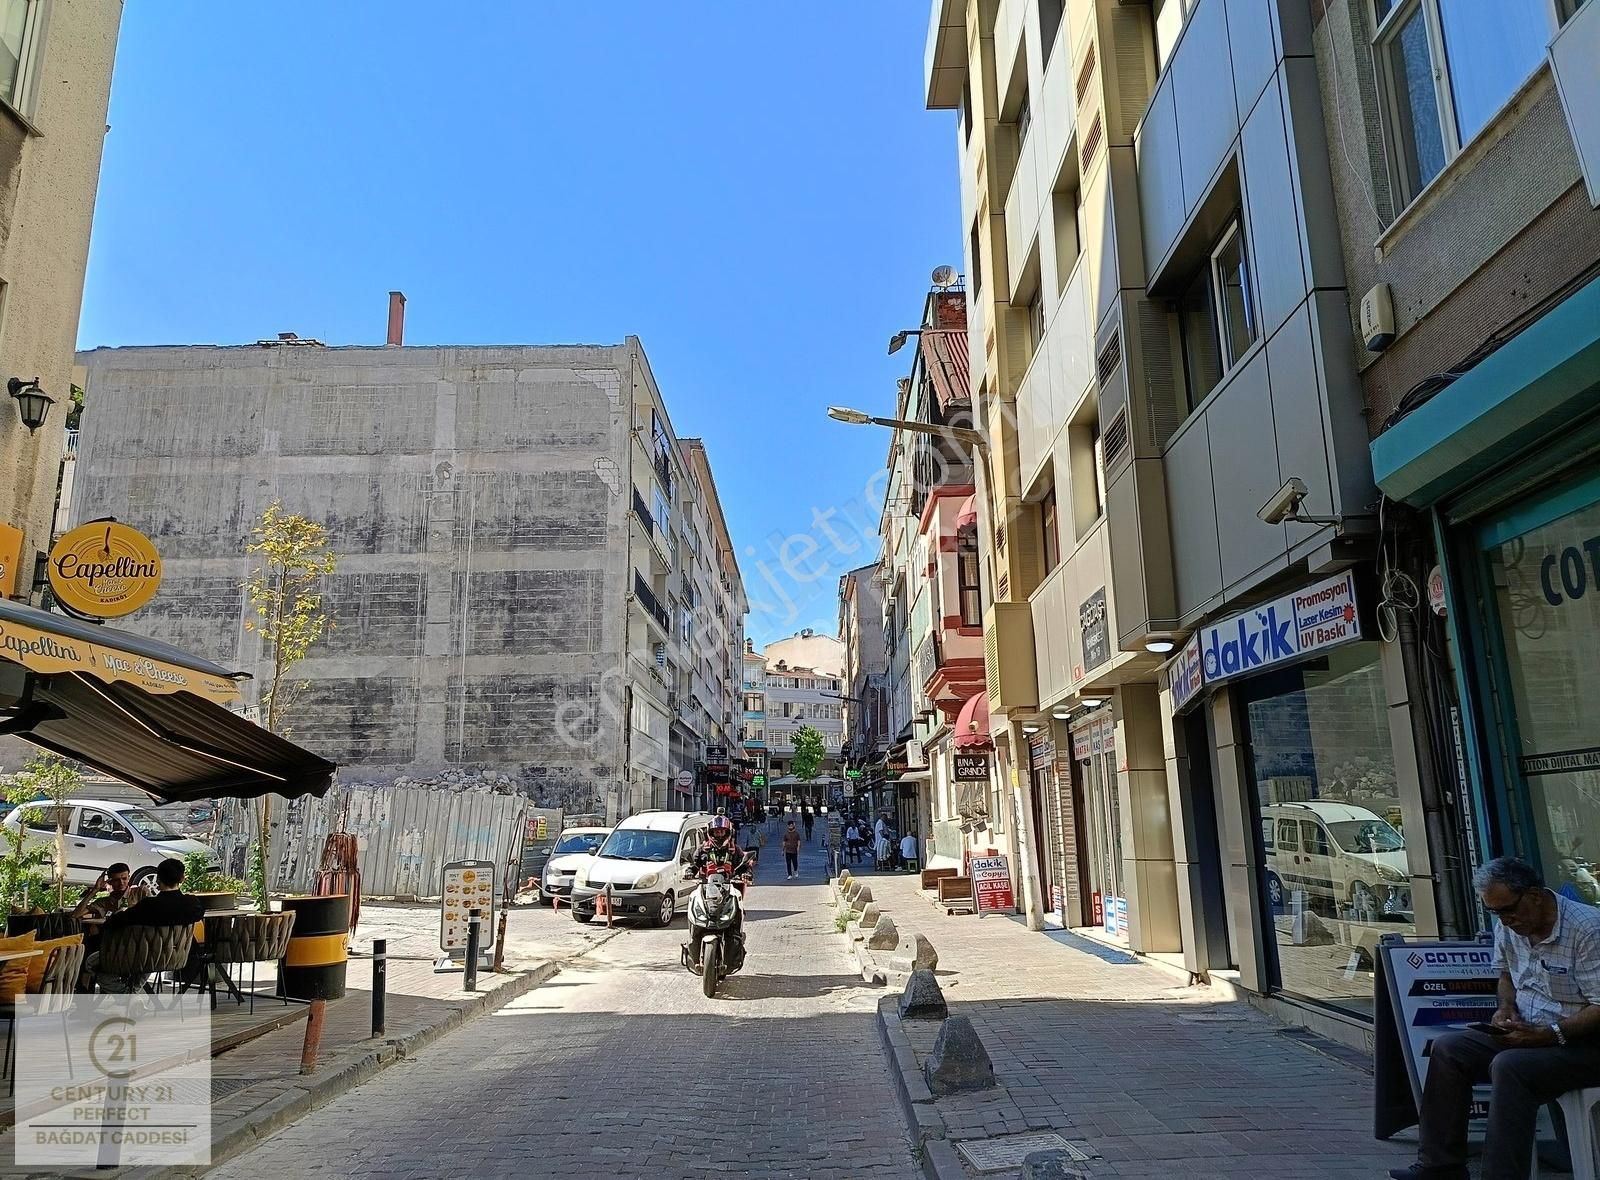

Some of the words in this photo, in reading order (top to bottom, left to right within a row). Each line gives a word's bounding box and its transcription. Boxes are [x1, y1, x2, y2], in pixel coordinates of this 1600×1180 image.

[53, 553, 158, 586] Capellini
[1296, 582, 1348, 611] Promosyon
[1299, 613, 1319, 628] Laser
[1319, 605, 1343, 622] Kesim
[1204, 606, 1295, 680] dakik
[1301, 630, 1314, 648] UV
[1316, 622, 1347, 644] Baskı
[0, 624, 82, 661] apellini
[102, 653, 132, 677] Mac
[142, 658, 188, 687] Cheese
[1584, 752, 1600, 765] MA
[974, 858, 1003, 869] dakik
[1424, 951, 1492, 964] COTTON
[1423, 981, 1447, 991] ÖZEL
